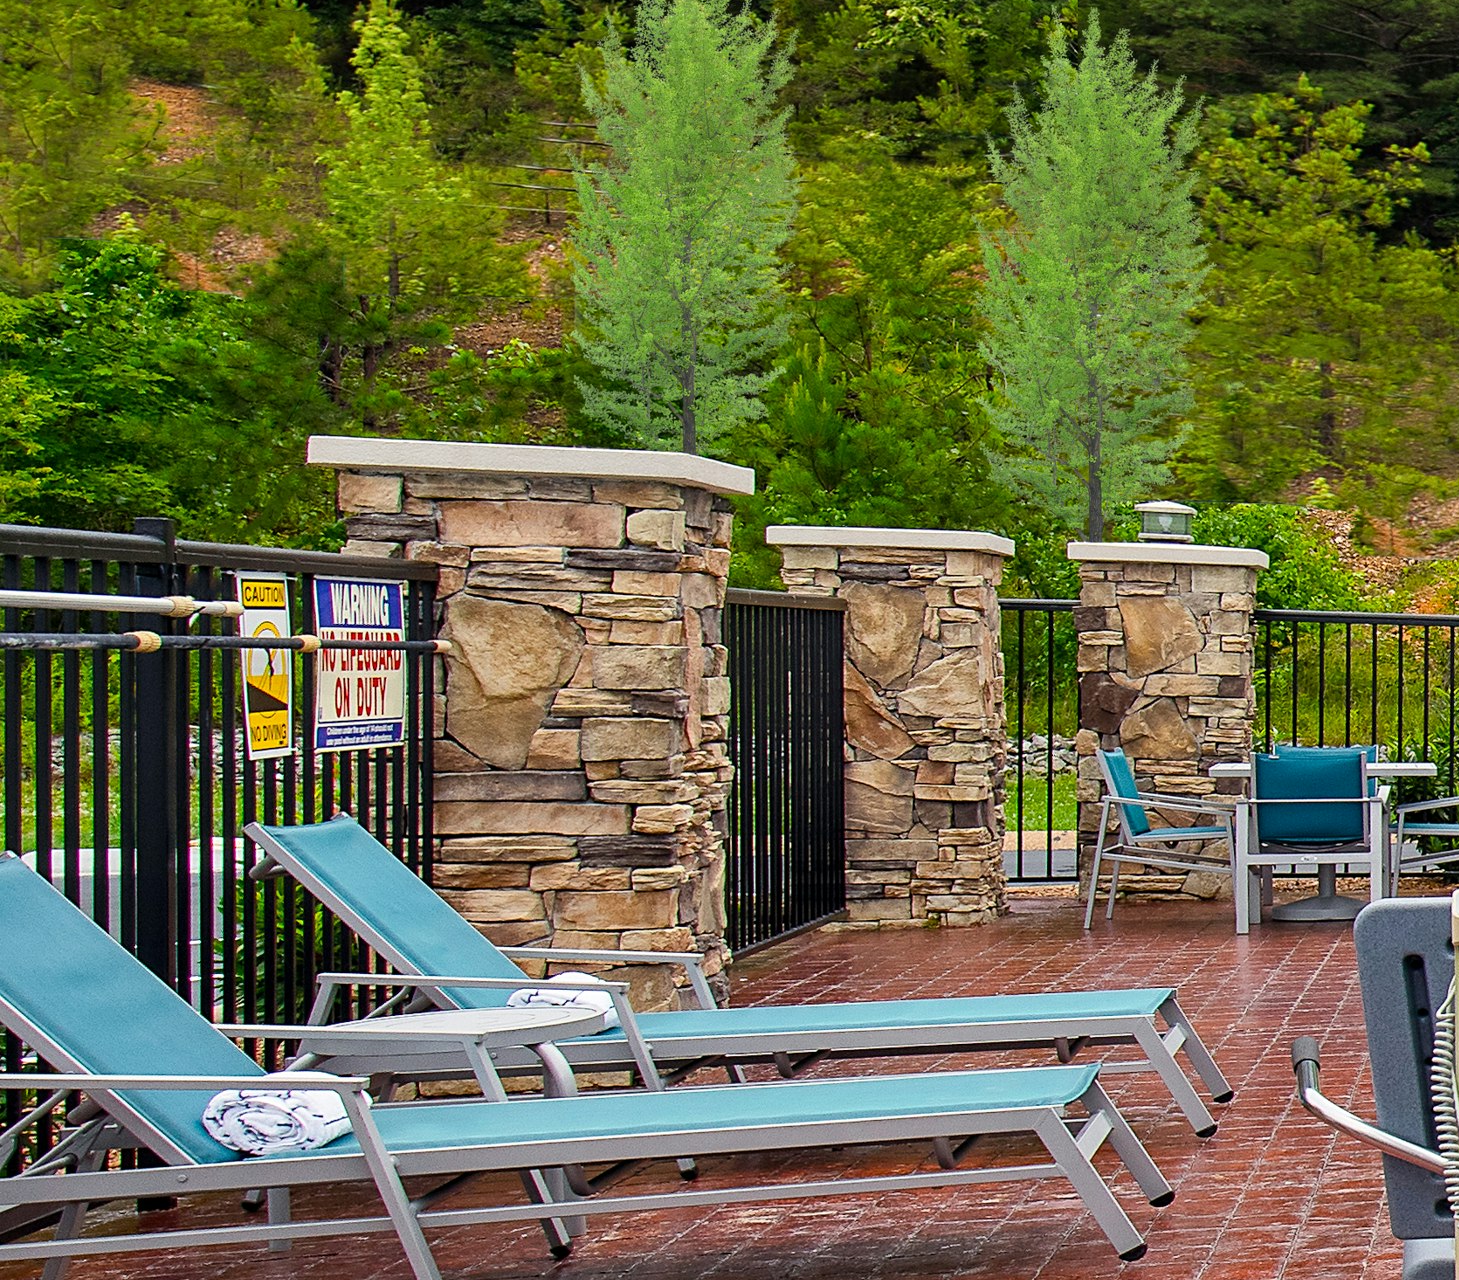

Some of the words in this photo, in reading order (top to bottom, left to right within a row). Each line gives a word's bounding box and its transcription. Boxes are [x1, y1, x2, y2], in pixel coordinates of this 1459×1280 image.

[245, 585, 284, 603] CAUTION
[331, 583, 389, 626] WARNING
[322, 631, 335, 672] NO
[341, 631, 400, 672] LIFEGUARD
[335, 677, 350, 718] ON
[357, 677, 387, 716] DUTY
[252, 726, 261, 742] NO
[263, 724, 286, 741] DIVING
